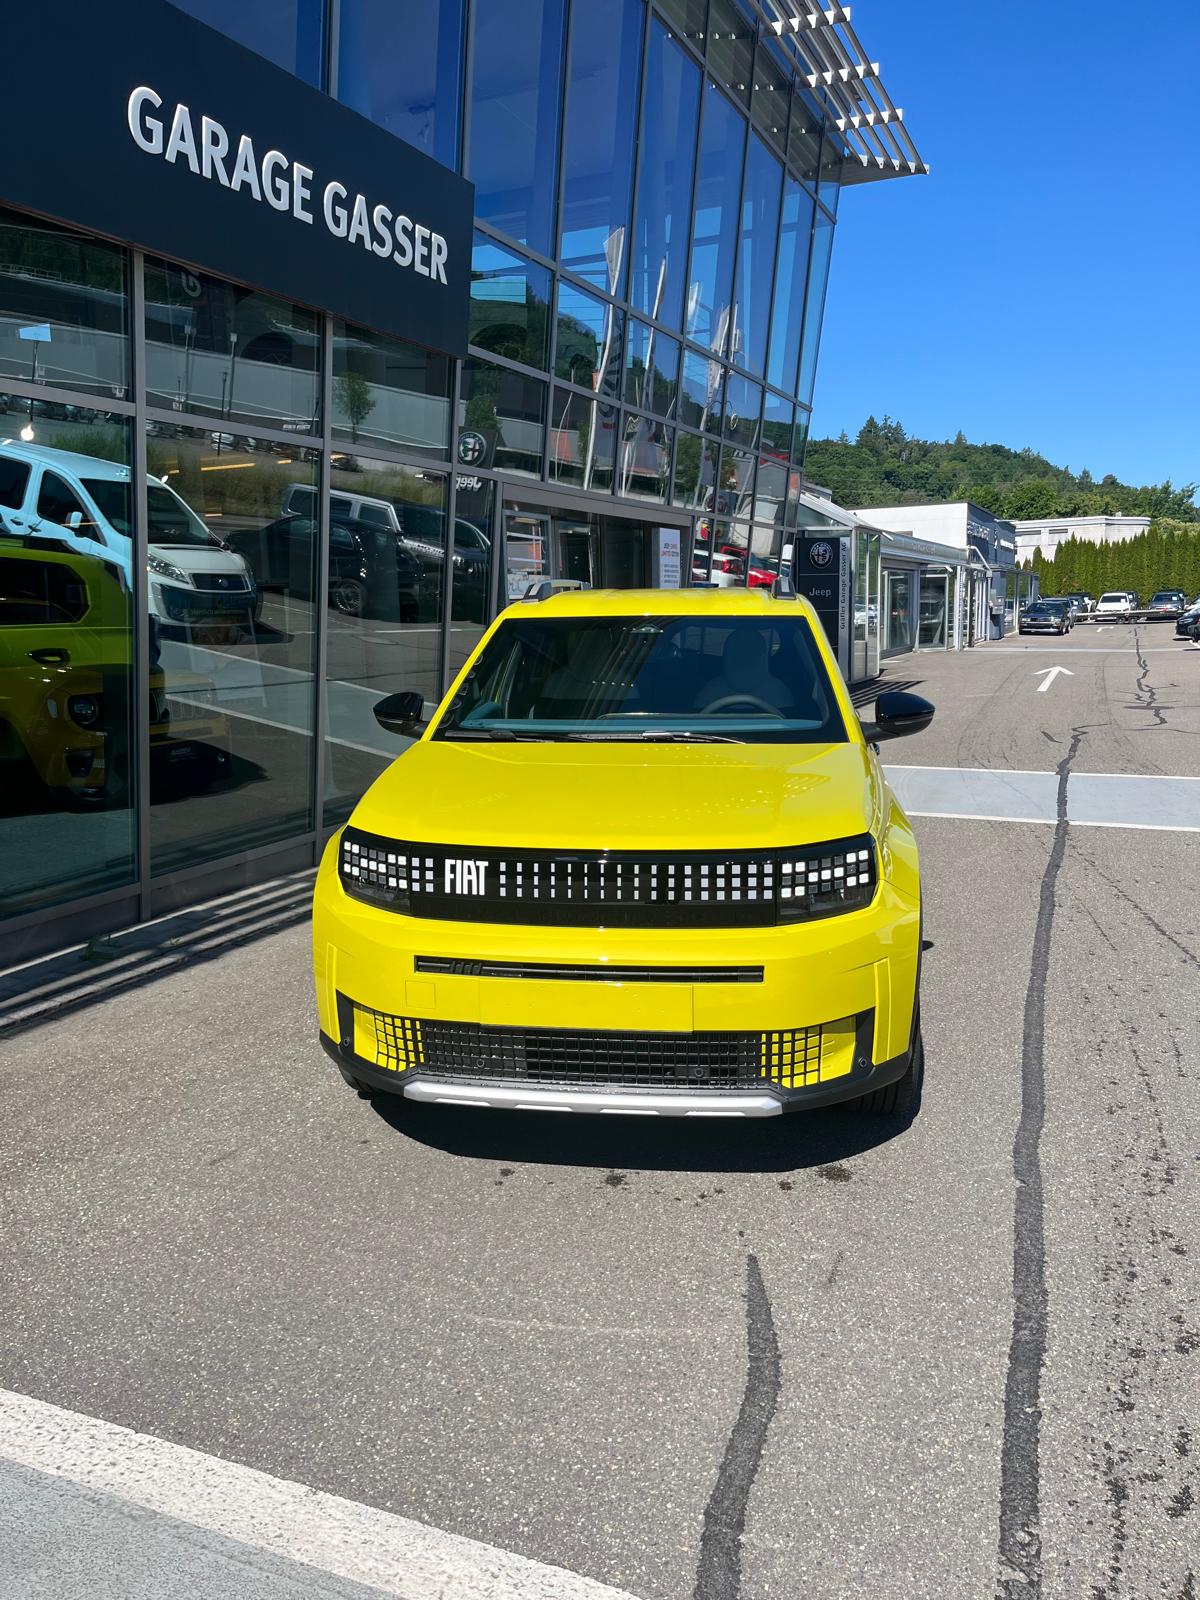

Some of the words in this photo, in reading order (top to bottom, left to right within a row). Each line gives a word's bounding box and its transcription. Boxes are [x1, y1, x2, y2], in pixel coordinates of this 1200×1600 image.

[128, 86, 313, 224] GARAGE
[323, 182, 448, 285] GASSER
[841, 542, 847, 553] AG
[809, 587, 831, 597] Jeep
[444, 858, 488, 896] FIAT
